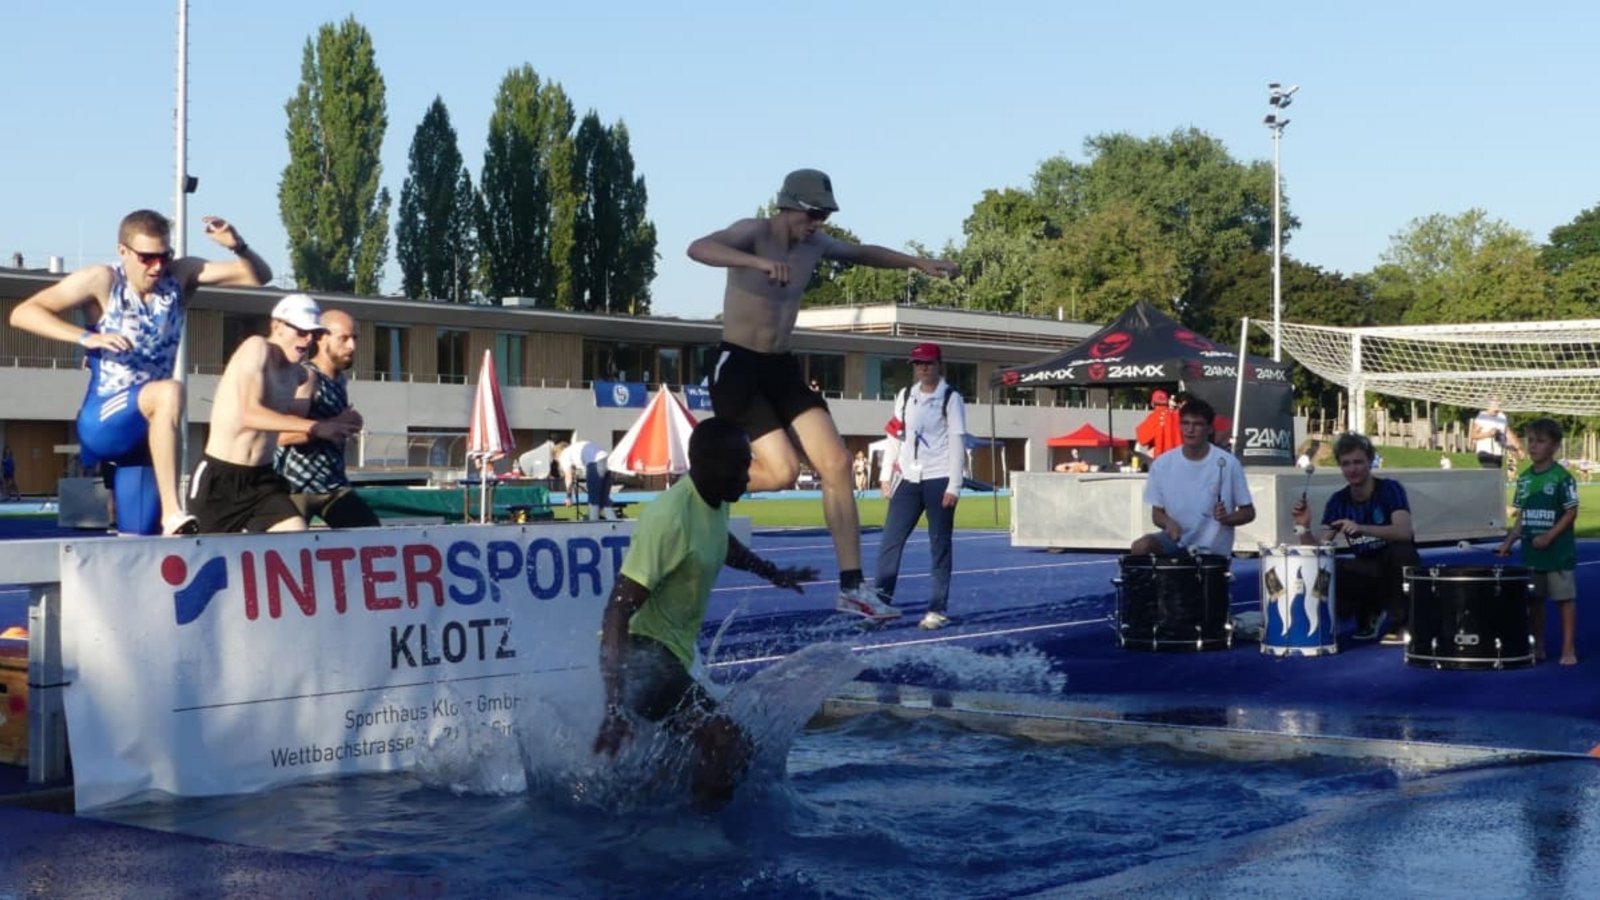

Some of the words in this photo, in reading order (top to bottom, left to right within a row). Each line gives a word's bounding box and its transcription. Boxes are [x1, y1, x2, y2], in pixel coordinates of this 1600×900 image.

[1108, 364, 1165, 378] 24MX
[1203, 365, 1239, 377] 24MX
[1255, 367, 1287, 380] 24MX
[1244, 427, 1292, 448] 24MX
[241, 535, 631, 620] INTERSPORT
[390, 617, 516, 669] KLOTZ
[345, 703, 428, 731] Sporthaus
[432, 697, 471, 718] Klo
[271, 736, 415, 768] Wettbachstrasse
